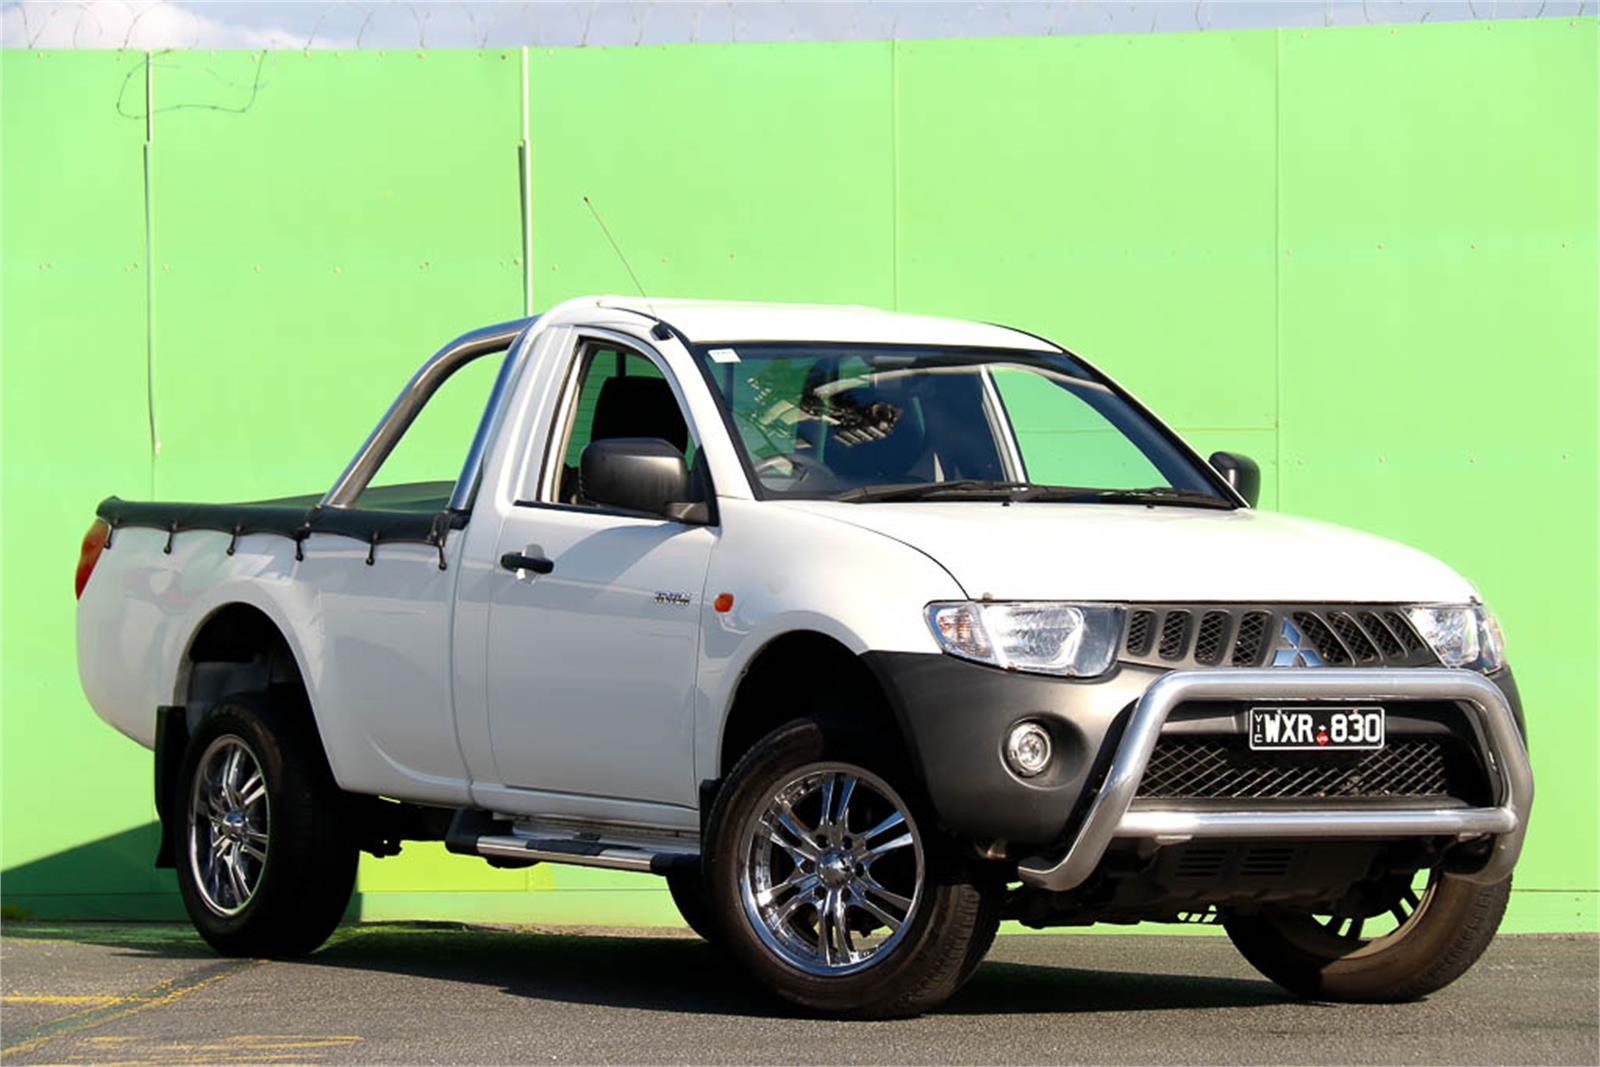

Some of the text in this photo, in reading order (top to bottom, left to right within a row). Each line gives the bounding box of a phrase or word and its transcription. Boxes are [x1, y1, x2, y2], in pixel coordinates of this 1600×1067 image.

[1254, 714, 1263, 743] VIC
[1264, 714, 1380, 742] WXR 830
